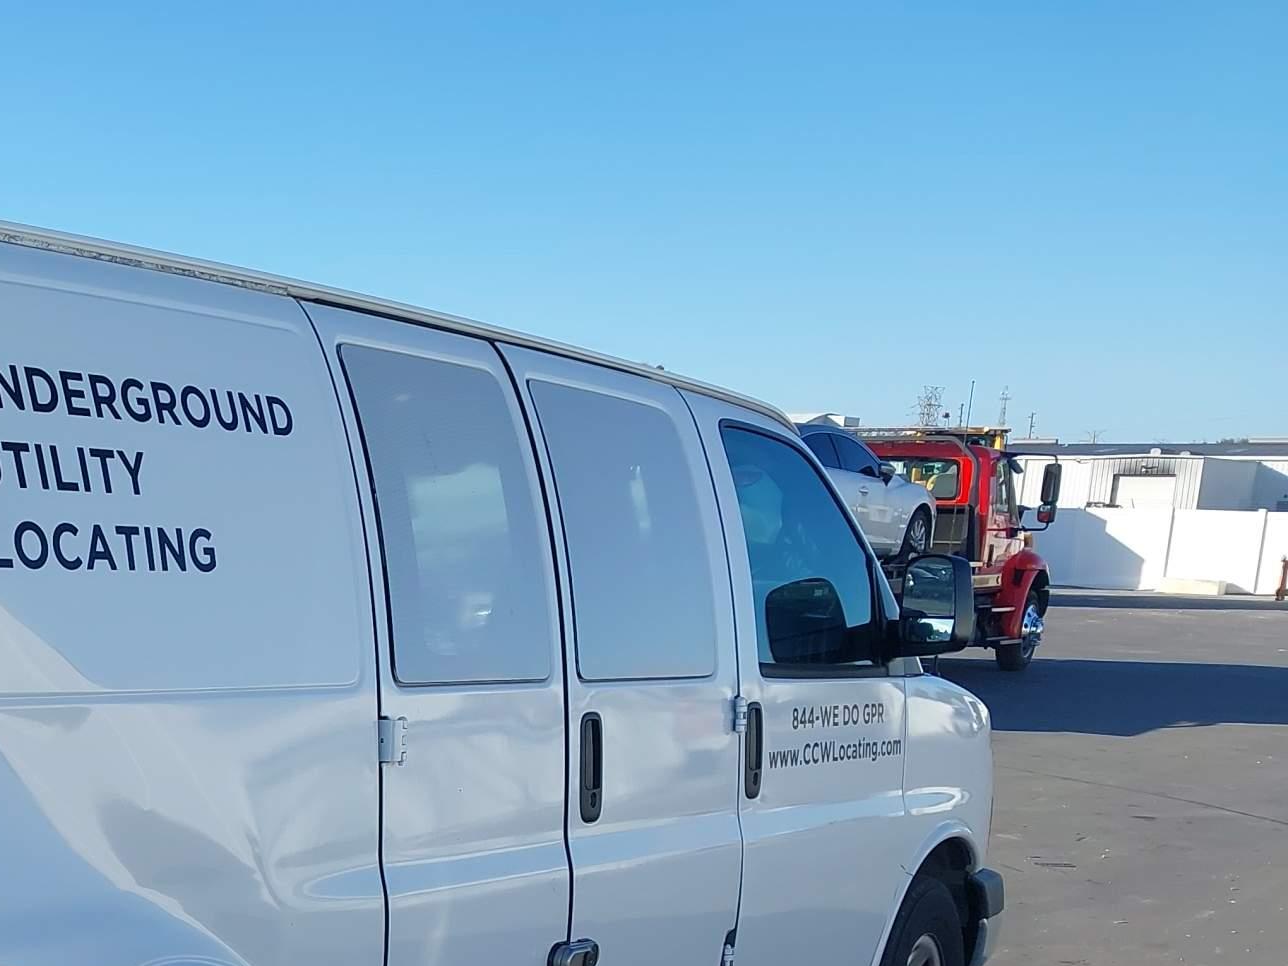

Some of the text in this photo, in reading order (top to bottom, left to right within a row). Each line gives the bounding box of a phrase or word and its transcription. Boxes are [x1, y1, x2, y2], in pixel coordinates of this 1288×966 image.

[792, 703, 885, 730] 844-WE DO GPR
[768, 738, 902, 769] www.CCWLocating.com
